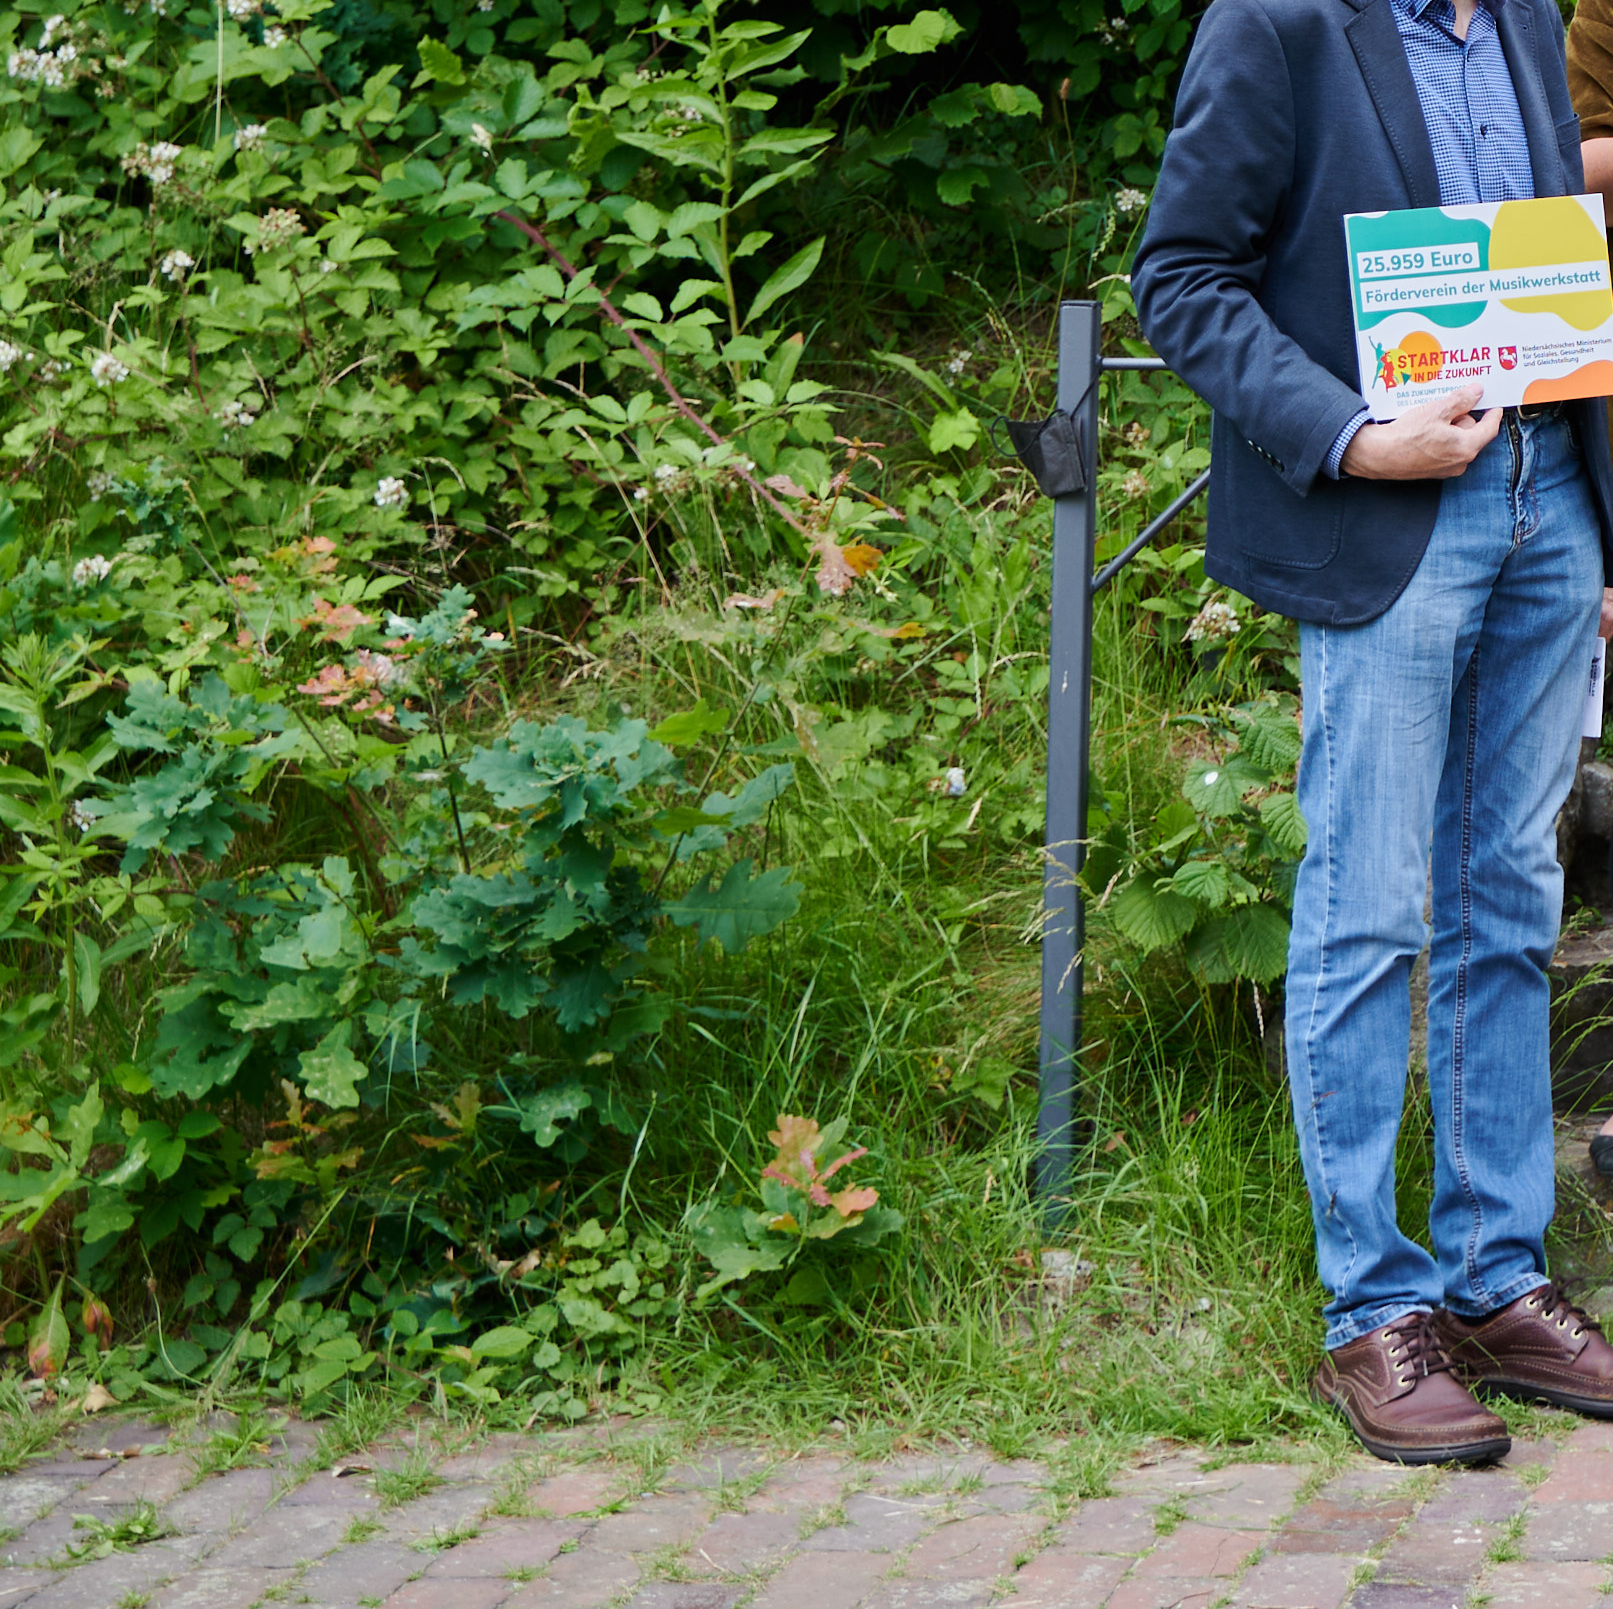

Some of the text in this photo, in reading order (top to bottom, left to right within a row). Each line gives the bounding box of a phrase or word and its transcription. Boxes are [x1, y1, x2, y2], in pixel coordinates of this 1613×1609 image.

[1362, 251, 1473, 273] 25.959 Euro
[1365, 270, 1601, 304] Förderverein der Musikwerkstatt
[1397, 346, 1490, 369] STARTKLAR
[1414, 365, 1491, 382] IN DIE ZUKUNFT
